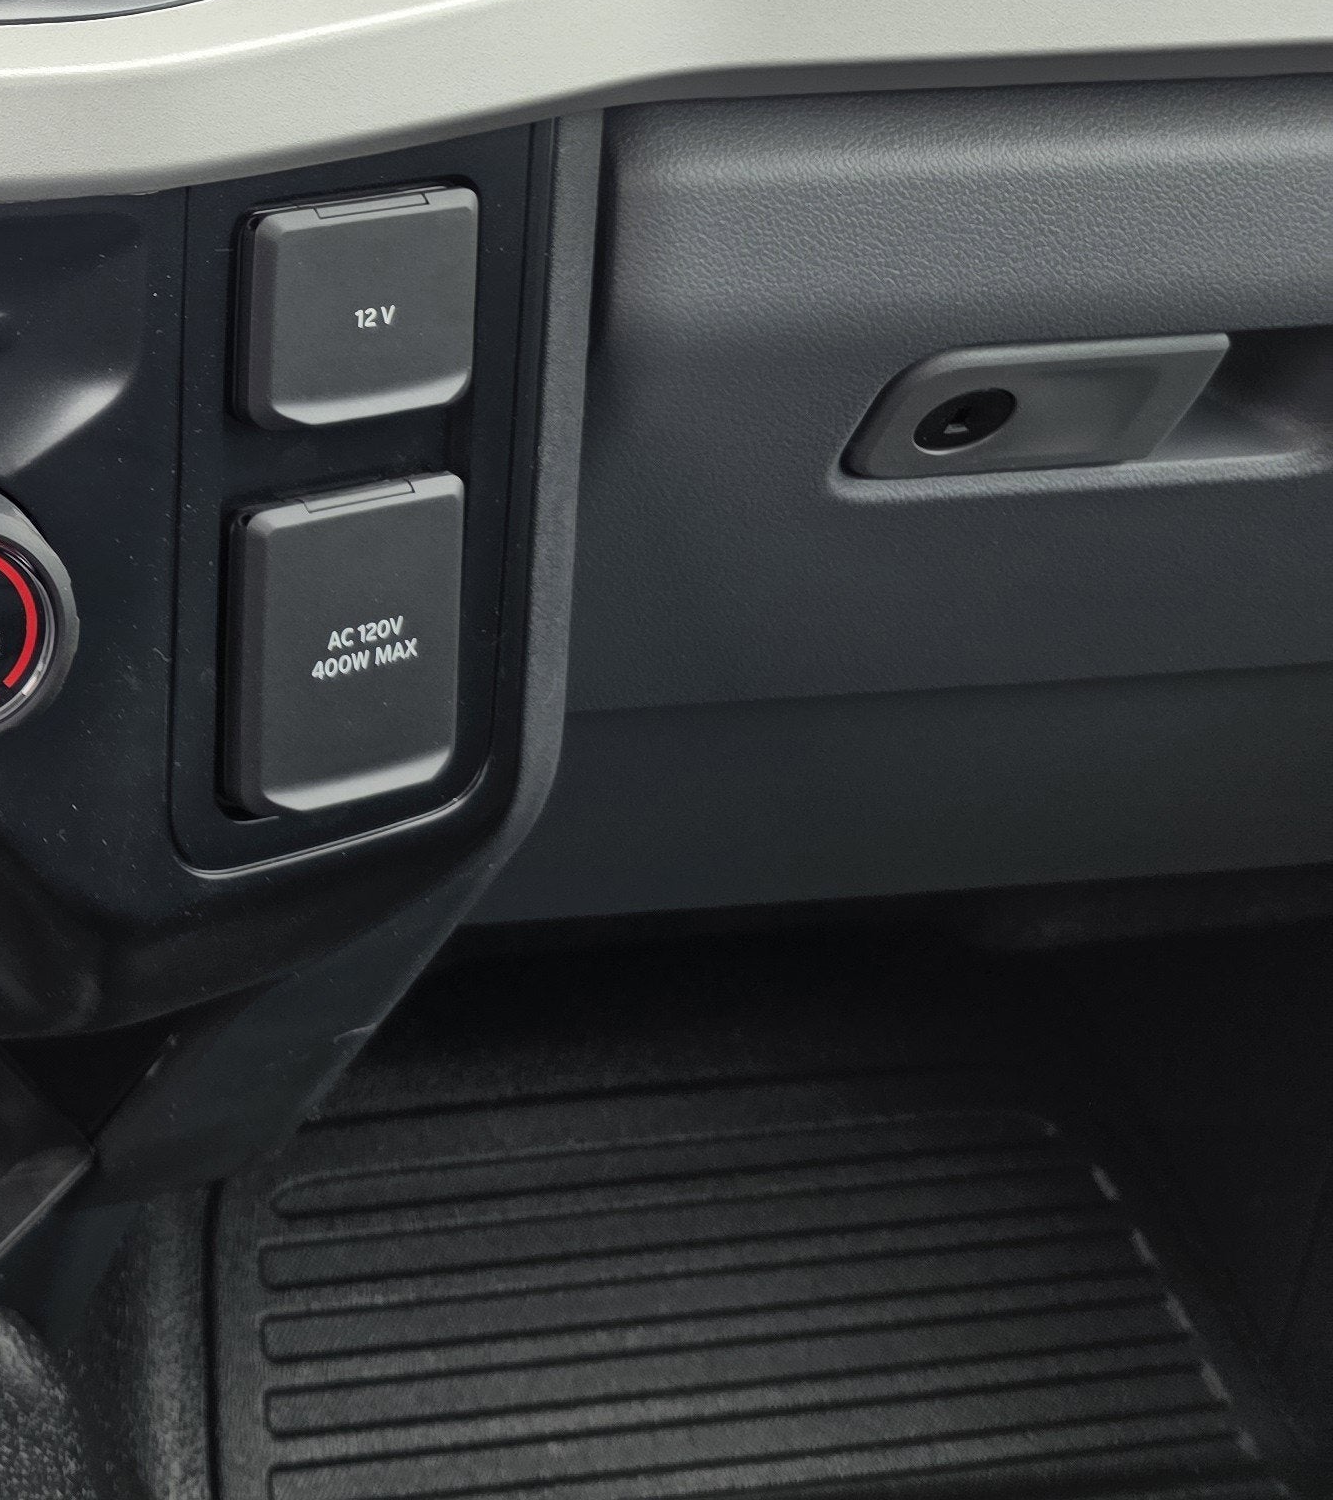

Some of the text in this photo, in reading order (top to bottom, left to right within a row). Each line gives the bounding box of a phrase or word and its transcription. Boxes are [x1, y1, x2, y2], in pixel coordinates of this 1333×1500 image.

[354, 304, 396, 329] 12 V
[327, 615, 404, 651] AC 120V
[311, 637, 418, 680] 400W MAX
